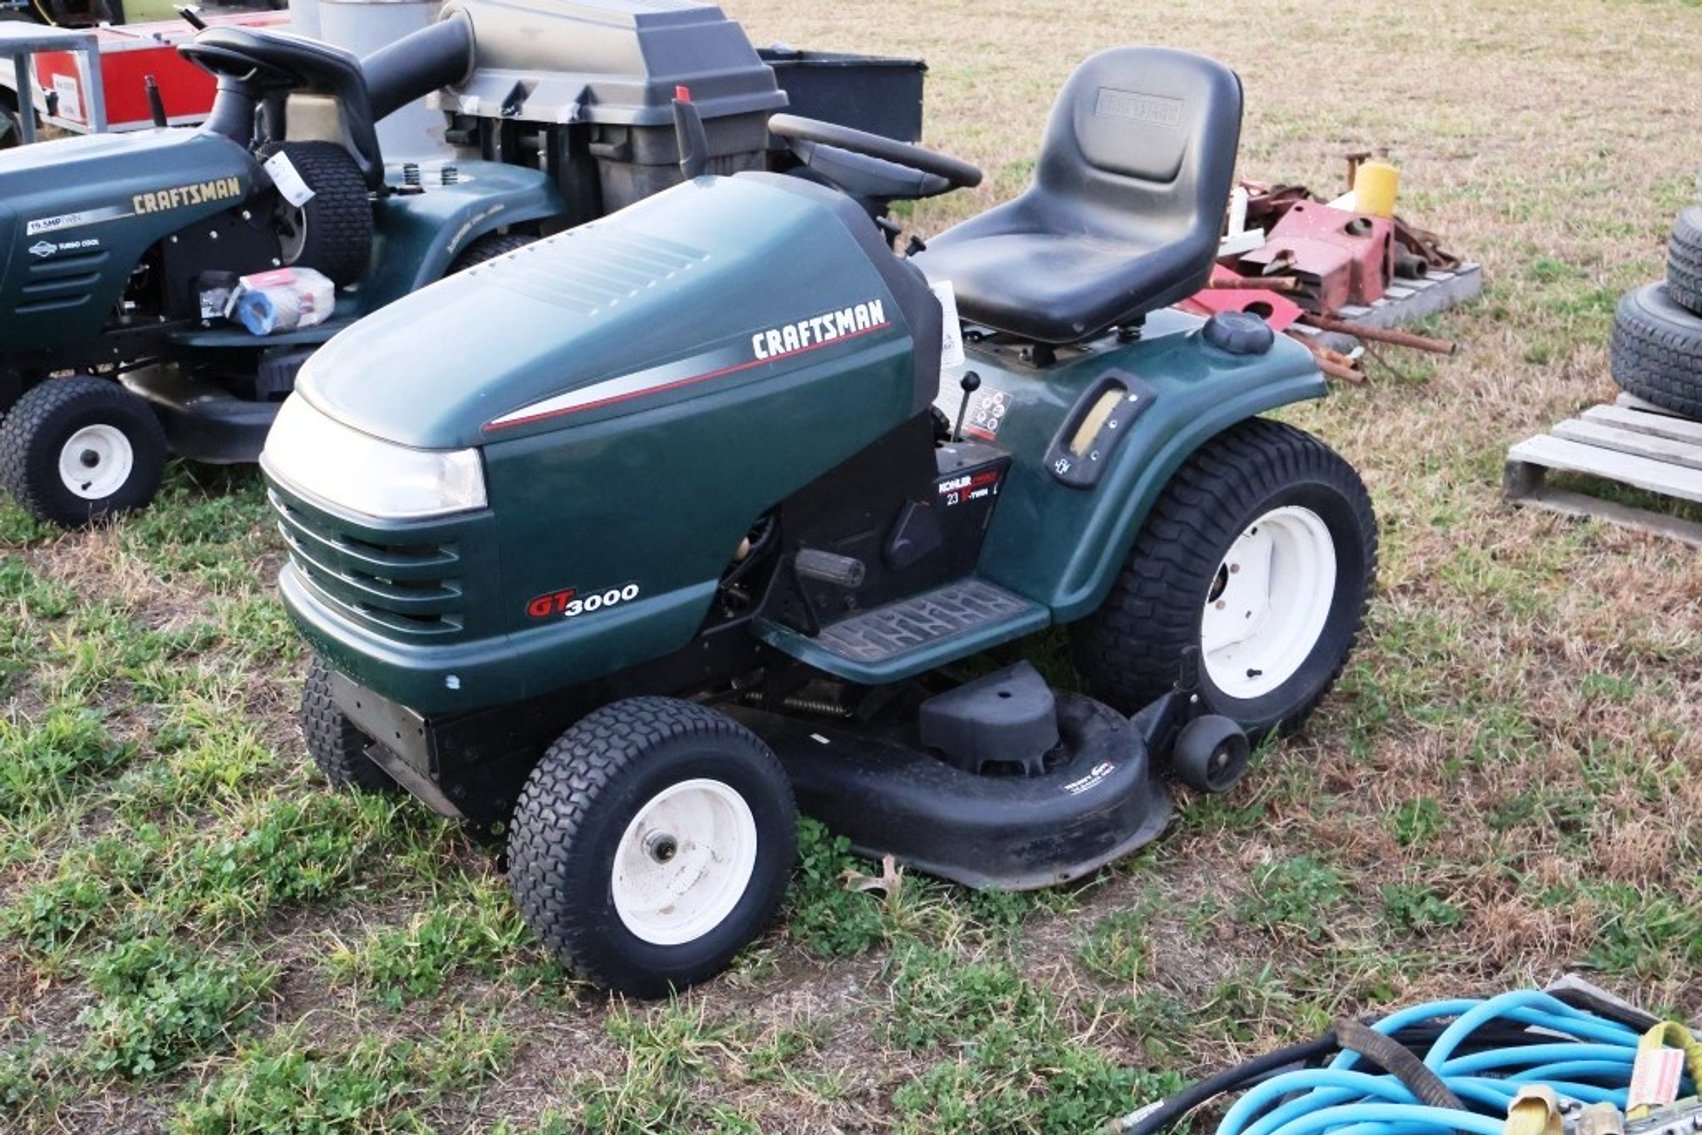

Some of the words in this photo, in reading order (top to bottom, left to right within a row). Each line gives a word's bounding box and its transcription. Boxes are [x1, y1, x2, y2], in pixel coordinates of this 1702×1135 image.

[133, 177, 240, 215] CRAFTSMAN
[751, 299, 886, 360] CRAFTSMAN
[939, 475, 971, 493] KOHLER
[947, 492, 959, 506] 23
